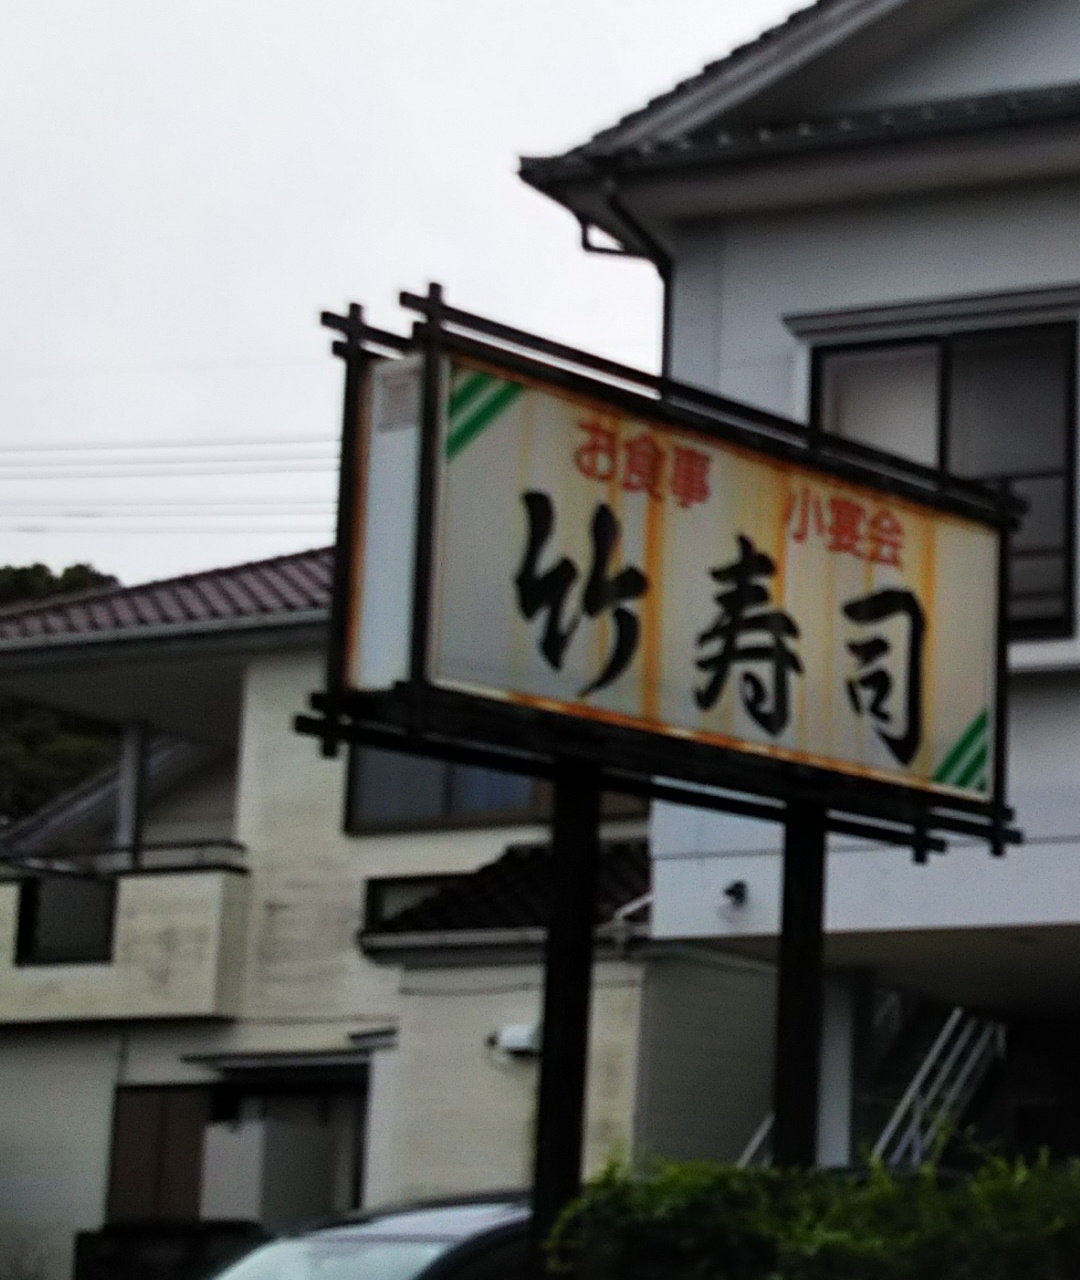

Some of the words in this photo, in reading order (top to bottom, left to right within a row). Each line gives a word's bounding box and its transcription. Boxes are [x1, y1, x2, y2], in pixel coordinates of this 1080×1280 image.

[573, 419, 713, 509] お食事
[785, 486, 905, 568] 小宴会
[515, 489, 927, 767] 竹寿司
